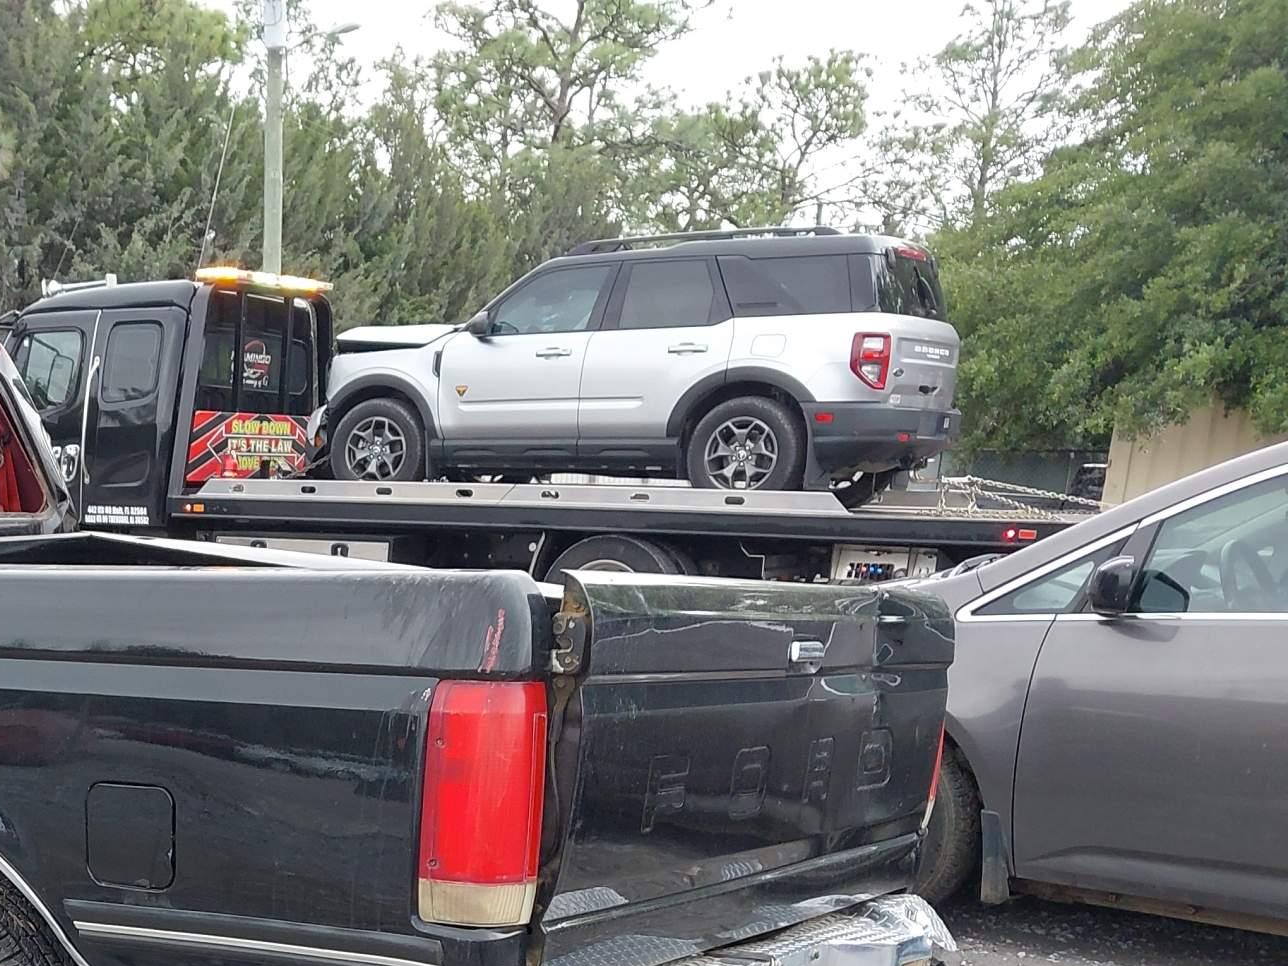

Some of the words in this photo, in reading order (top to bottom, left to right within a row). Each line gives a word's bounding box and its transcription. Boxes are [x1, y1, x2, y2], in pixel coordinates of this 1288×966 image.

[232, 420, 259, 434] SLOW
[262, 421, 292, 435] DOWN
[250, 440, 270, 453] THE
[271, 440, 292, 453] LAW
[640, 726, 894, 834] FORD
